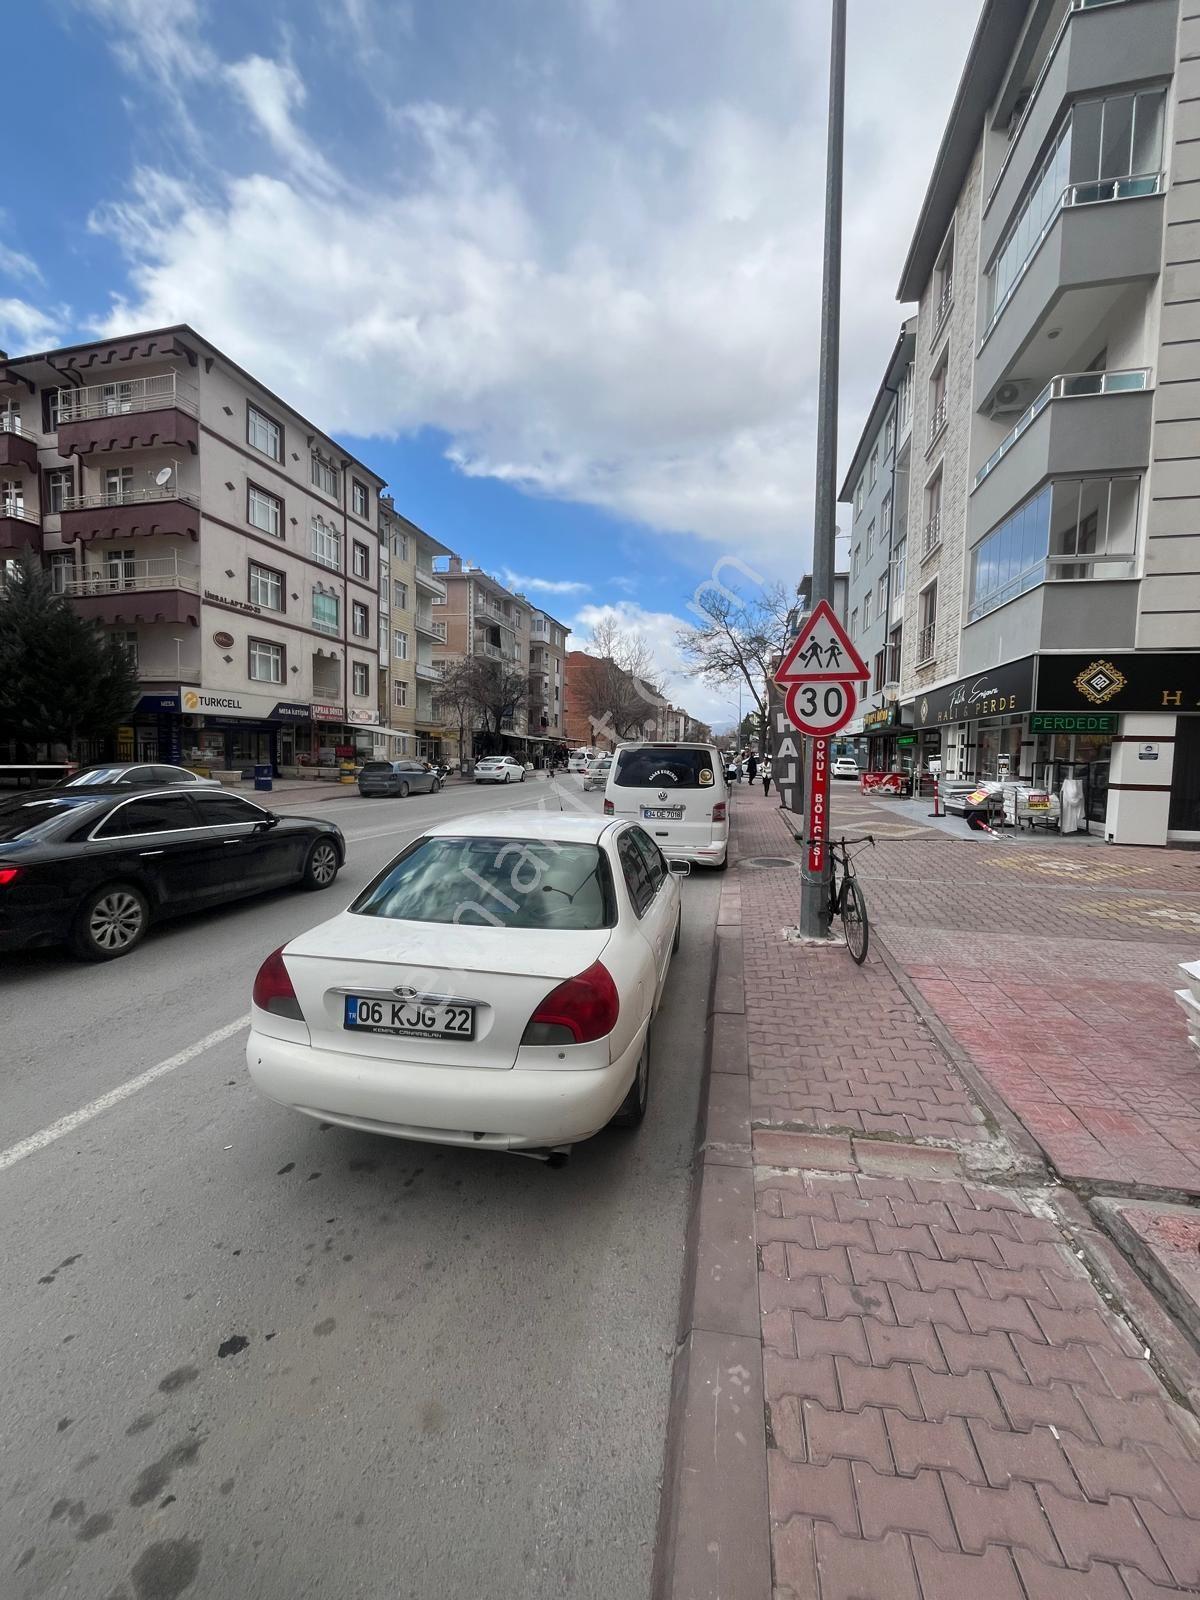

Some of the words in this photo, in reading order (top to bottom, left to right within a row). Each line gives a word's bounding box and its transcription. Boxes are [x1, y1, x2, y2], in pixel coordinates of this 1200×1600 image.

[198, 696, 242, 709] TURKCELL
[278, 707, 291, 715] MESA
[800, 687, 842, 717] 30
[975, 695, 1016, 715] PERDE
[1032, 717, 1110, 730] PERDEDE
[815, 740, 825, 781] OKUL
[358, 1001, 383, 1024] 06
[391, 1004, 436, 1028] KJG
[444, 1008, 470, 1032] 22
